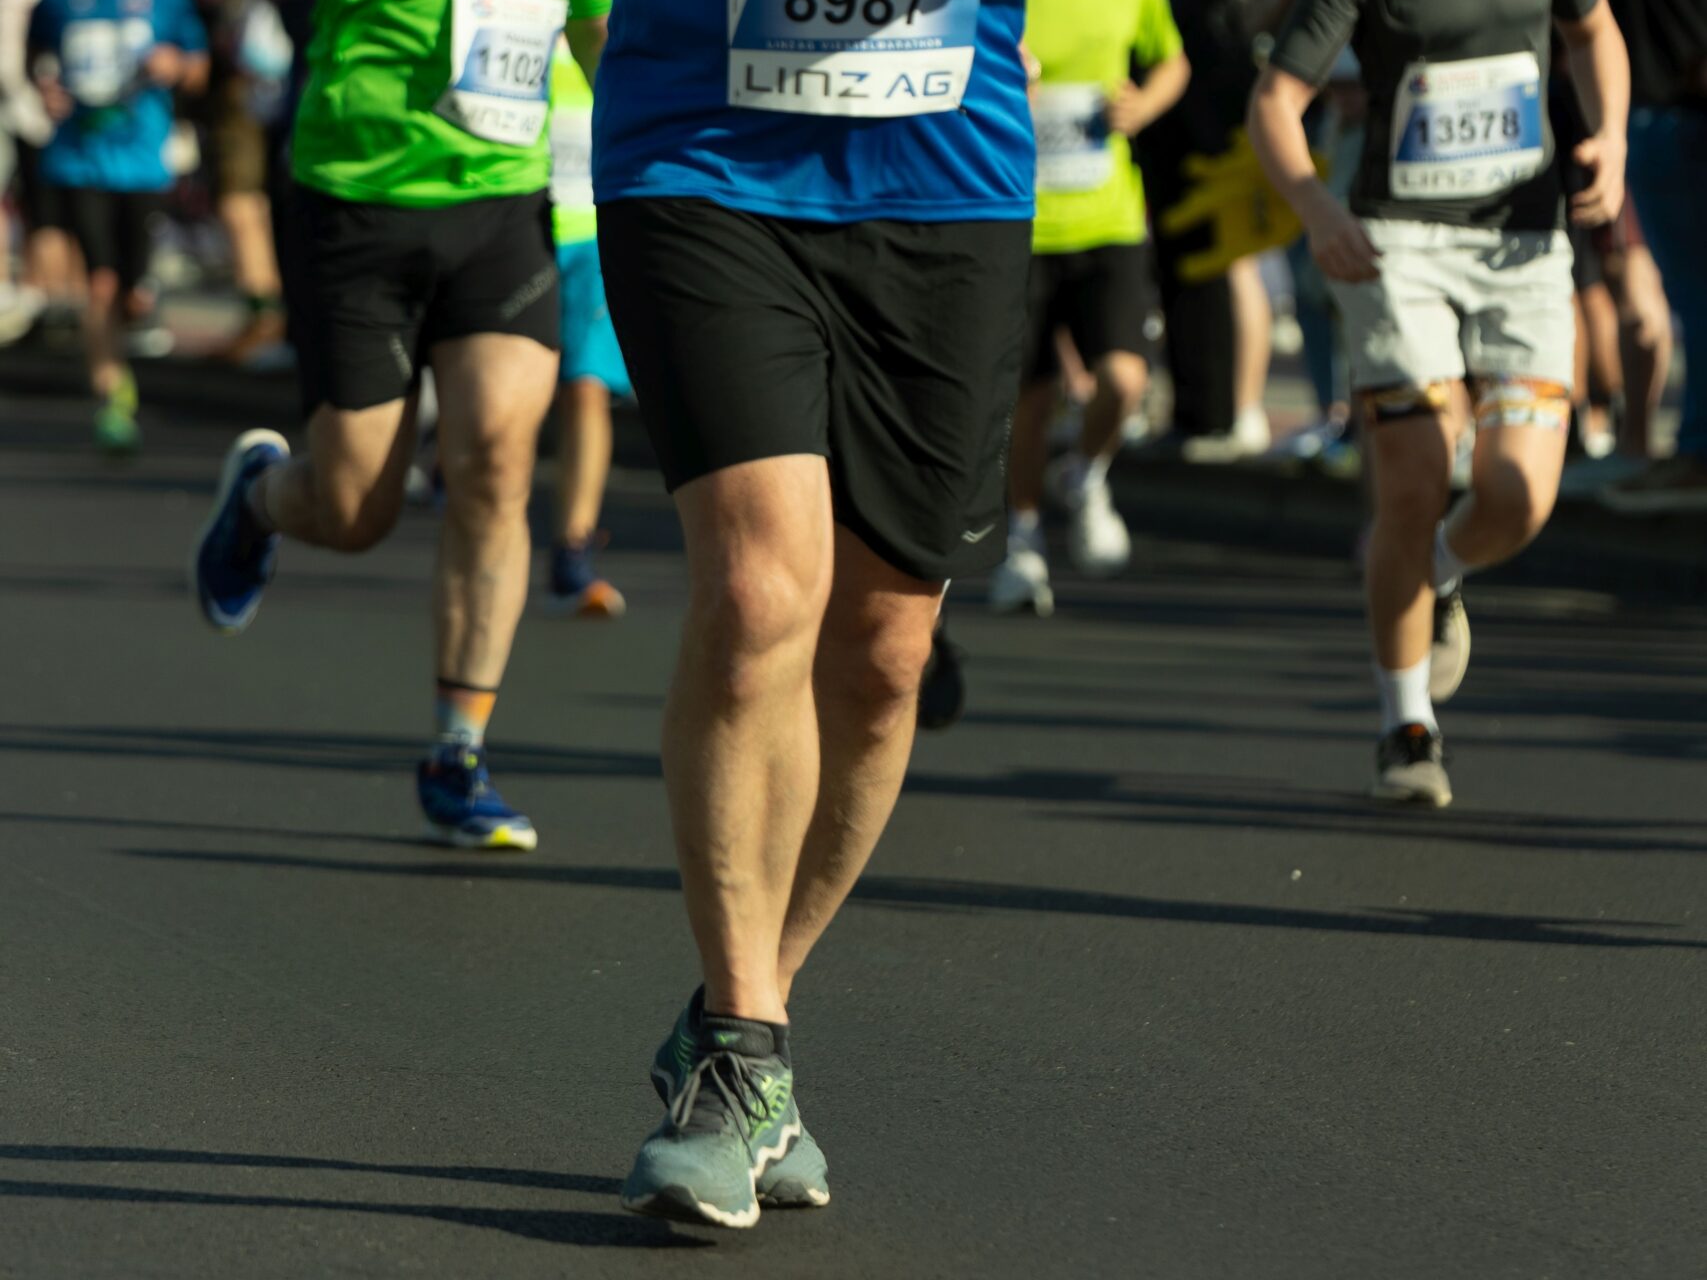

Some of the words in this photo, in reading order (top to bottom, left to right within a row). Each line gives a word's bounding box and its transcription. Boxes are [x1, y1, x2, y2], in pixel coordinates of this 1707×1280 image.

[745, 64, 869, 99] LINZ
[885, 70, 953, 99] AG
[1415, 108, 1520, 148] 13578
